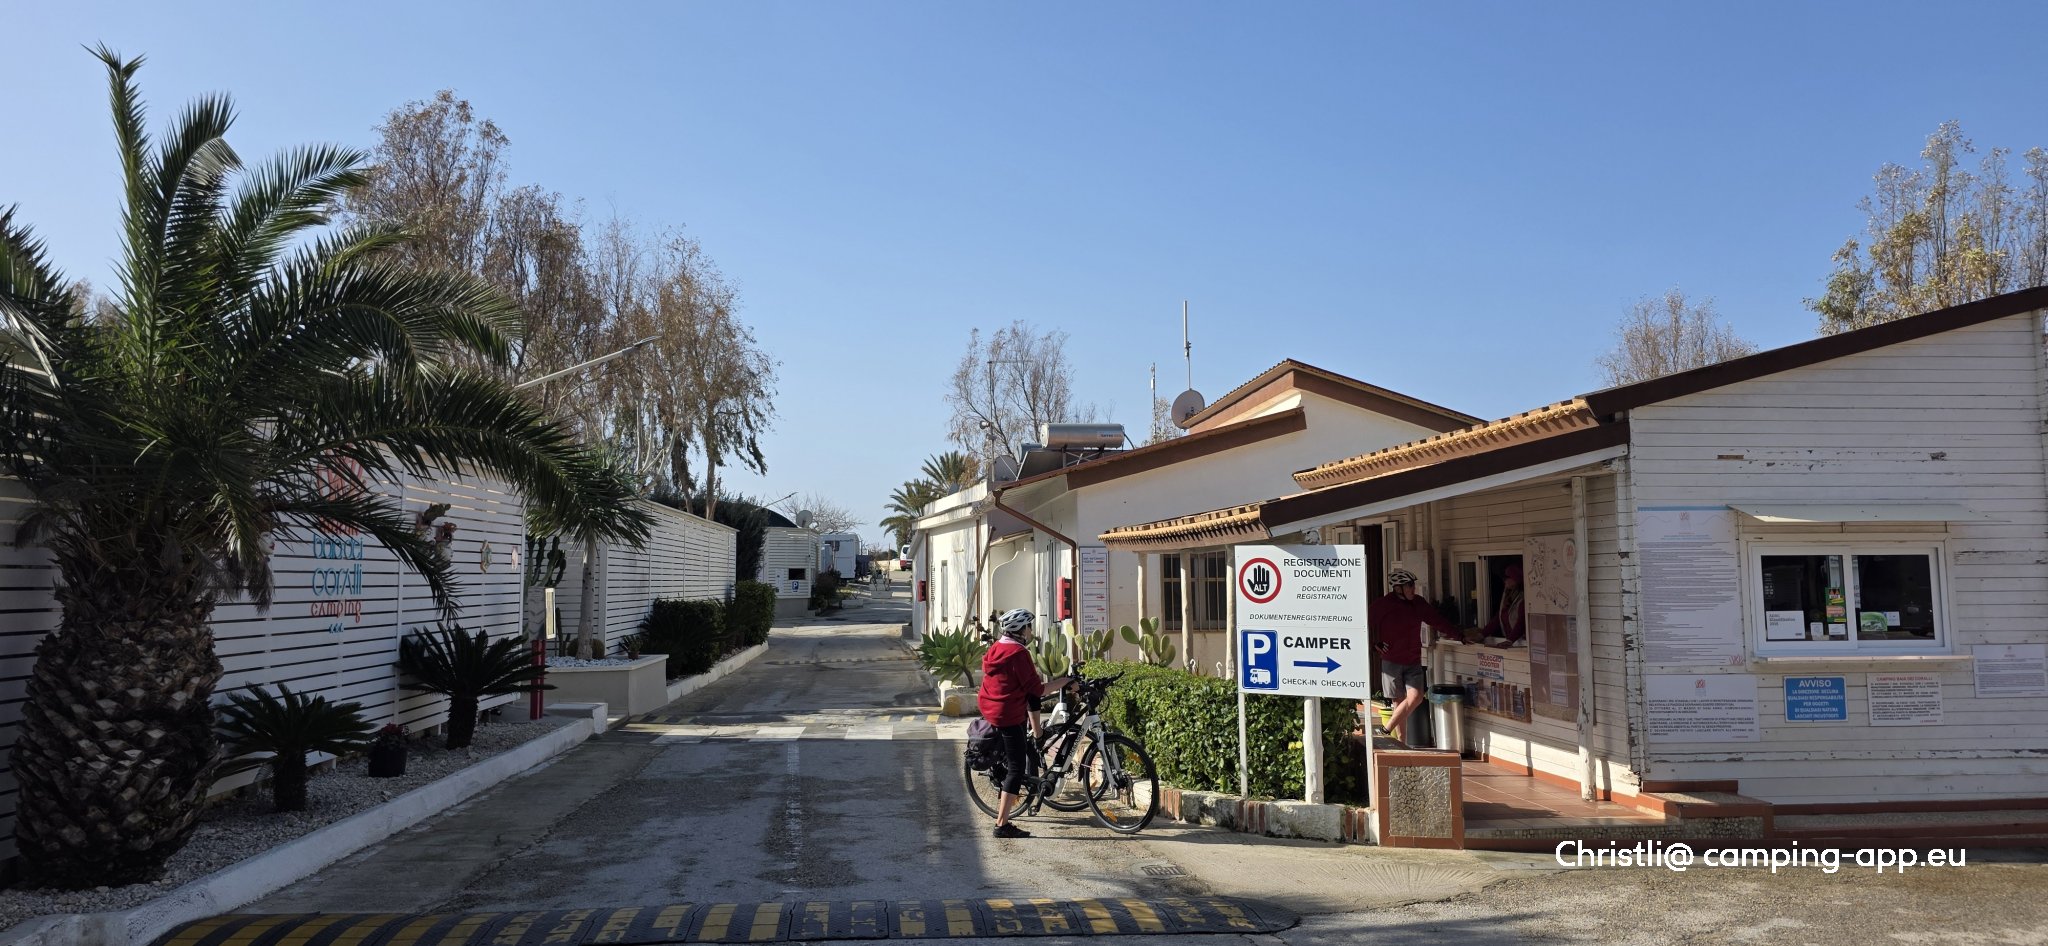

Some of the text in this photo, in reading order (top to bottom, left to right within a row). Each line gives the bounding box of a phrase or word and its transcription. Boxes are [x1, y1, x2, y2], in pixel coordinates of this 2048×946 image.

[1283, 558, 1362, 568] REGISTRAZIONE
[1293, 569, 1351, 578] DOCUMENTI
[1253, 583, 1268, 592] ALT
[1249, 613, 1353, 622] DOKUMENTENREGISTRIERUNG
[1283, 636, 1352, 650] CAMPER
[1246, 633, 1271, 666] P
[1282, 678, 1366, 688] CHECK-IN CHECK-OUT
[1798, 679, 1832, 687] AVVISO
